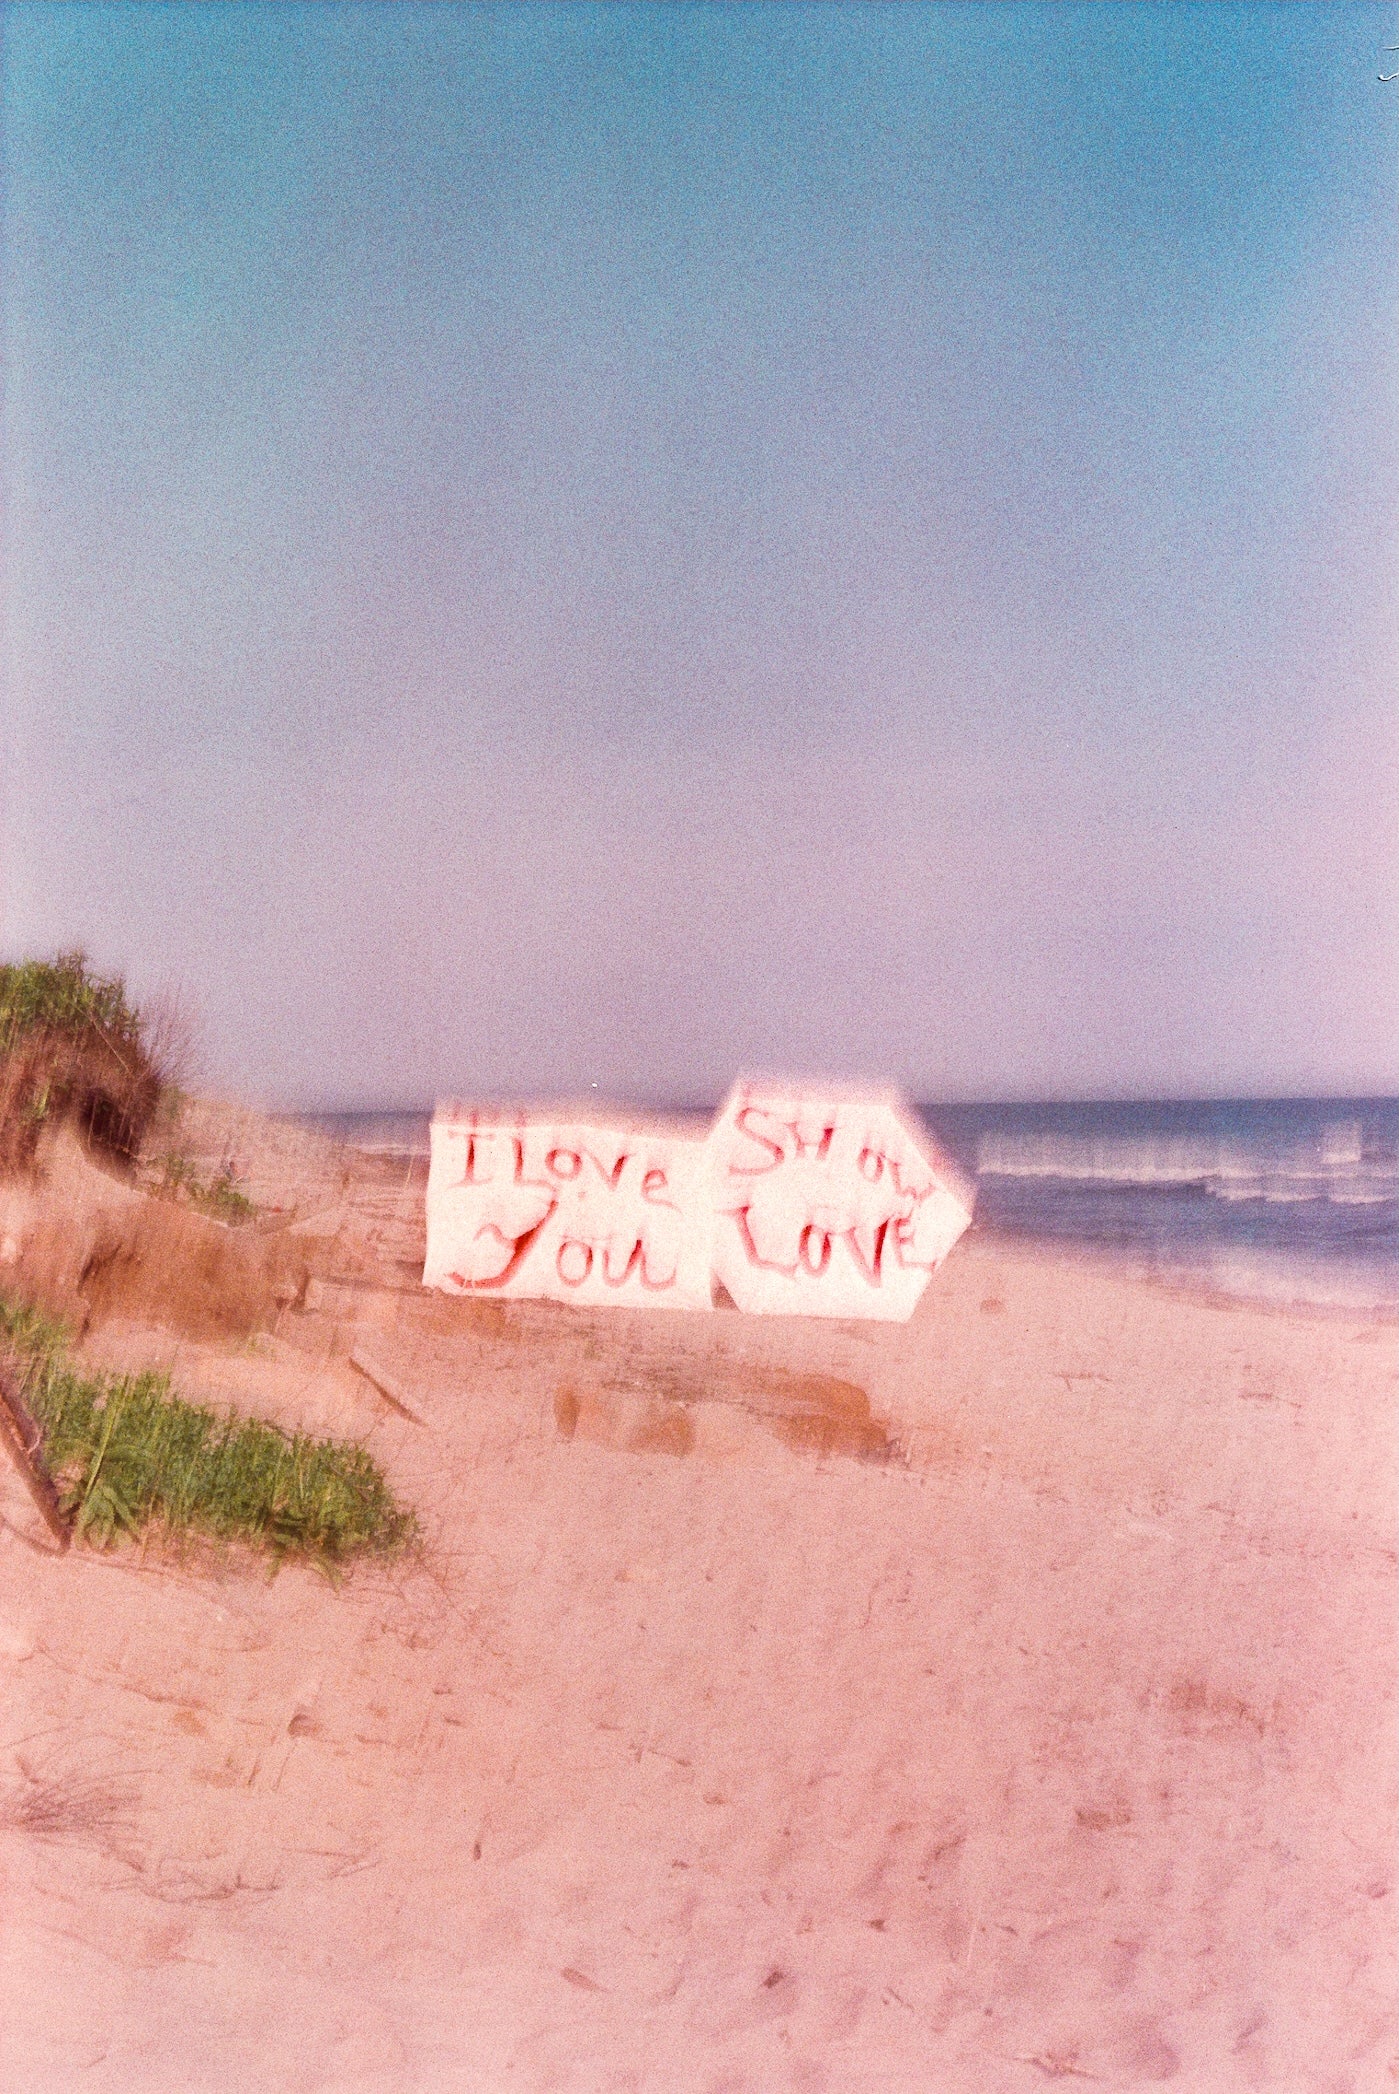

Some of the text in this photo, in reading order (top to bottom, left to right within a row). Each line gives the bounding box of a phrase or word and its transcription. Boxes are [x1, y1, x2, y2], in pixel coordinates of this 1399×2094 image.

[449, 1129, 493, 1188] I
[446, 1196, 678, 1290] You
[716, 1205, 938, 1288] LOVE
